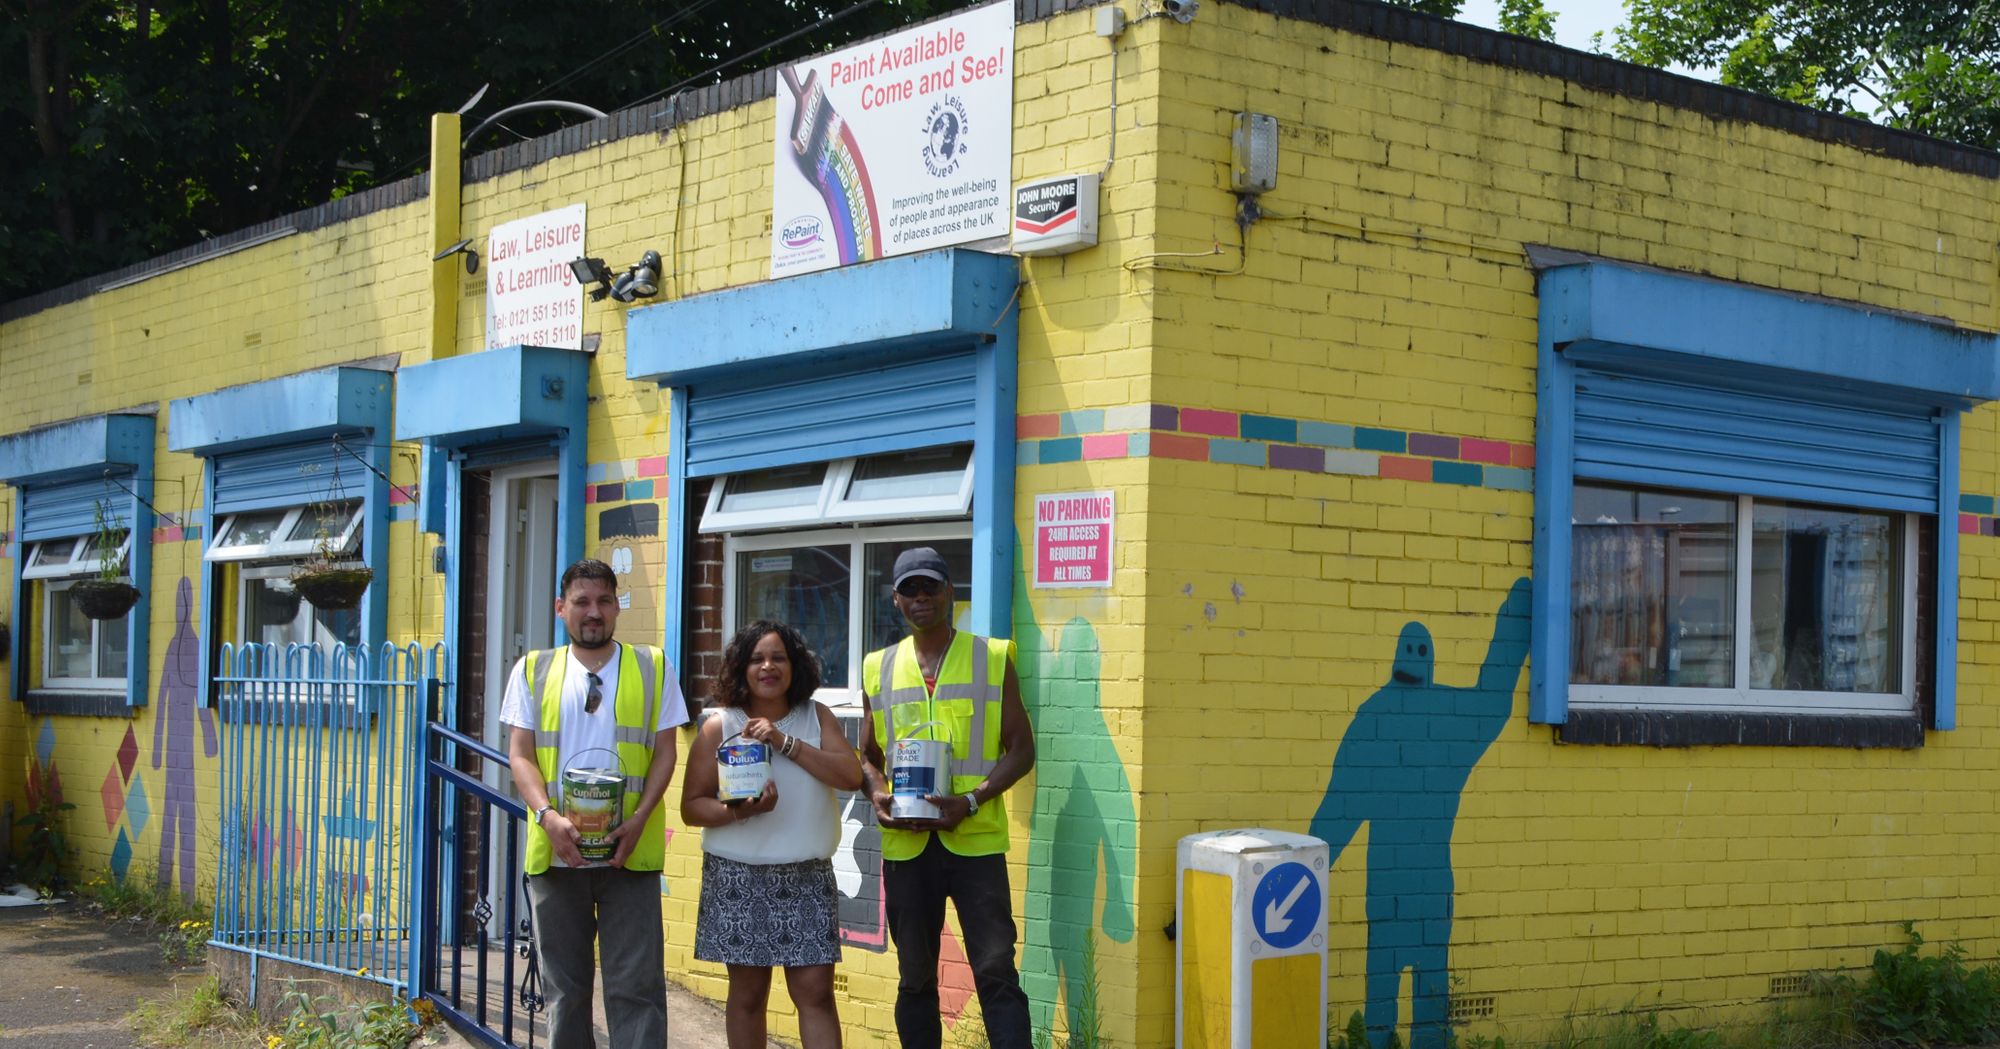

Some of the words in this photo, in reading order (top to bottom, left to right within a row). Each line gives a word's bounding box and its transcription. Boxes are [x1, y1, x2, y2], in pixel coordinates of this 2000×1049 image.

[830, 52, 875, 88] Paint
[879, 27, 965, 74] Available
[861, 78, 913, 111] Come
[919, 60, 955, 96] and
[961, 46, 1004, 84] See!
[944, 92, 969, 135] Leisure
[922, 145, 960, 178] Learning
[840, 144, 860, 182] SAVE
[855, 182, 872, 239] WASTE
[891, 191, 934, 210] Improving
[935, 187, 950, 201] the
[951, 177, 997, 197] well-being
[1018, 189, 1040, 205] JOHN
[1041, 183, 1075, 199] MOORE
[1028, 199, 1060, 215] Security
[834, 161, 850, 190] AND
[845, 190, 865, 257] PROSPER
[889, 214, 899, 228] of
[899, 209, 928, 228] people
[929, 204, 946, 219] and
[947, 195, 1000, 217] appearance
[491, 239, 521, 263] Law,
[525, 222, 581, 254] Leisure
[781, 221, 820, 241] RePaint
[893, 230, 902, 244] of
[903, 226, 931, 244] places
[932, 219, 962, 236] across
[963, 216, 978, 230] the
[980, 211, 995, 227] UK
[496, 270, 505, 297] &
[509, 256, 573, 293] Learning
[492, 313, 507, 331] Tel:
[509, 306, 530, 328] 0121
[532, 303, 549, 322] 551
[551, 298, 576, 318] 5115
[532, 329, 549, 347] 551
[552, 323, 576, 343] 5110
[1038, 500, 1056, 522] NO
[1057, 496, 1111, 521] PARKING
[1048, 527, 1068, 542] 24HR
[1069, 525, 1100, 541] ACCESS
[1049, 545, 1087, 562] REQUIRED
[1087, 545, 1097, 560] AT
[1053, 566, 1067, 581] ALL
[1067, 565, 1092, 581] TIMES
[728, 755, 756, 764] Dulux
[573, 788, 611, 799] Cuprinol
